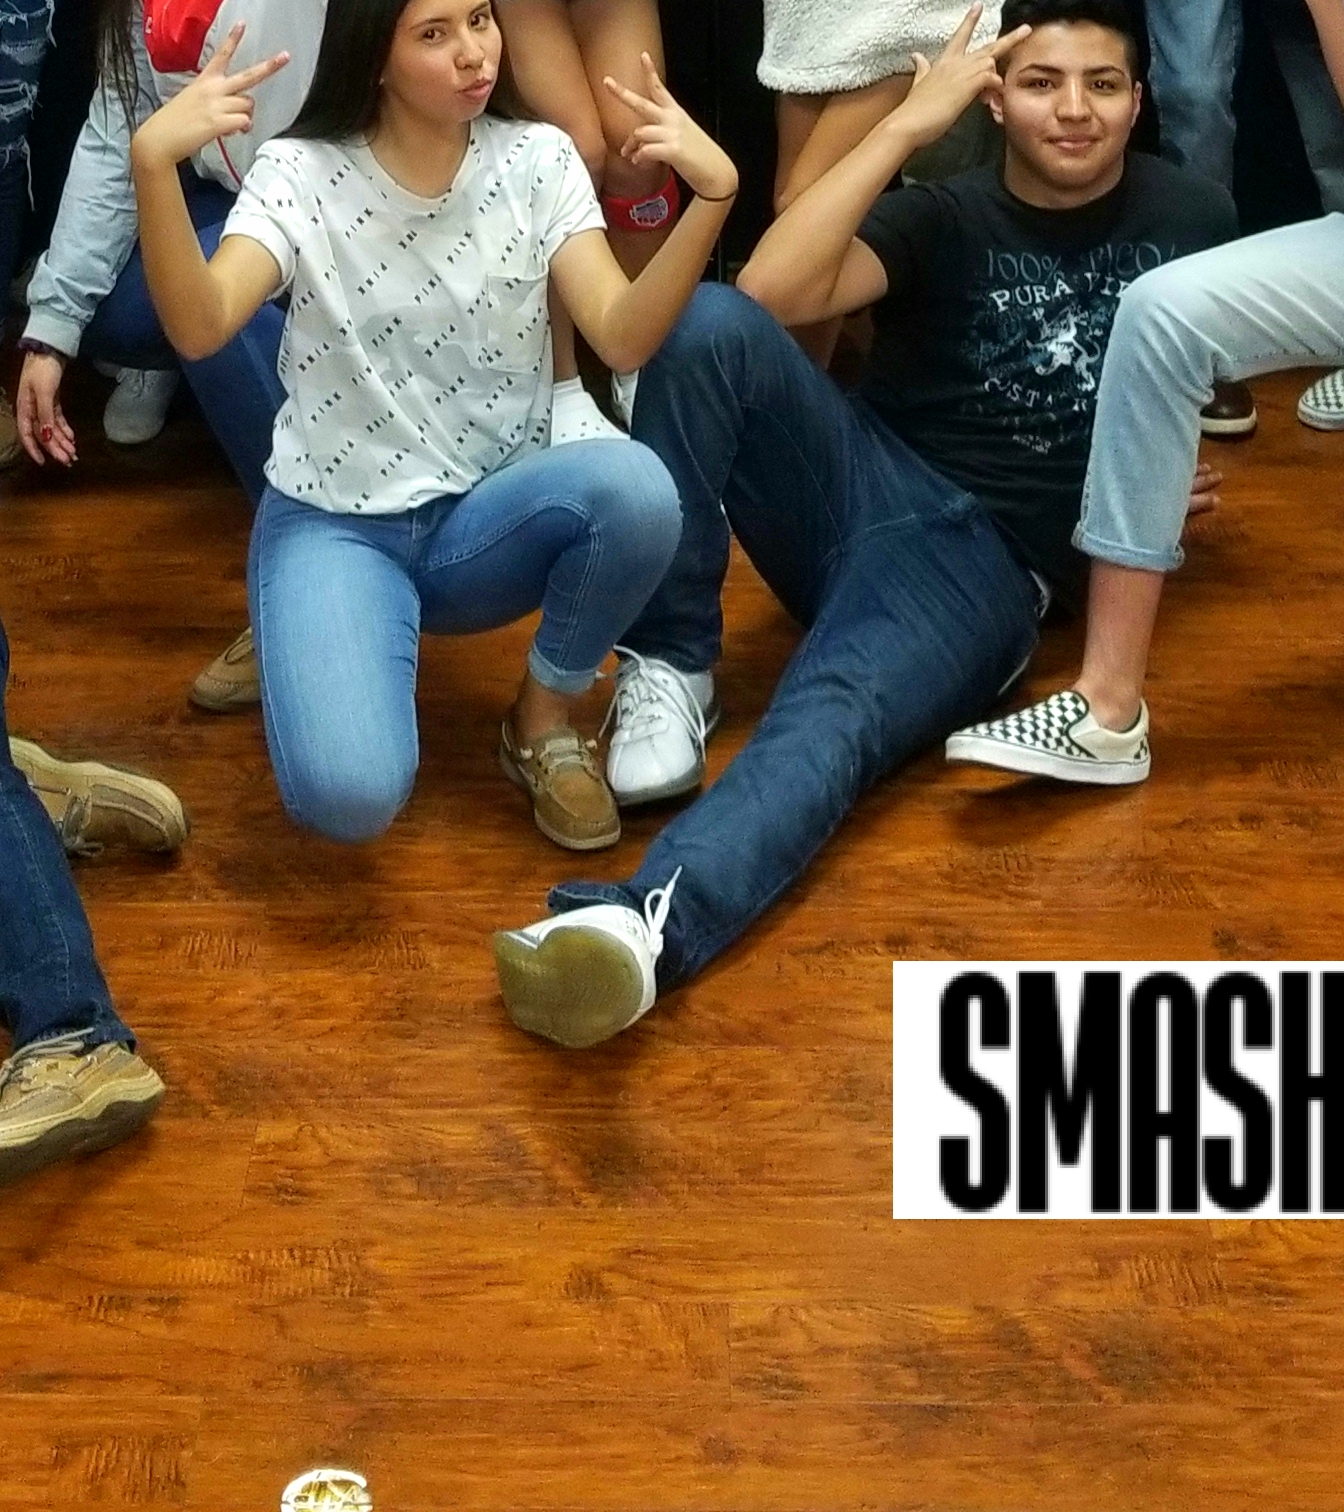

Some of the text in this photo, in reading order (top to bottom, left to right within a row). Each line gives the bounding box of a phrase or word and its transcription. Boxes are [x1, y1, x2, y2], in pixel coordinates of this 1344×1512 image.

[989, 277, 1075, 314] PURA
[298, 341, 331, 373] PINK
[424, 323, 457, 359] PINK
